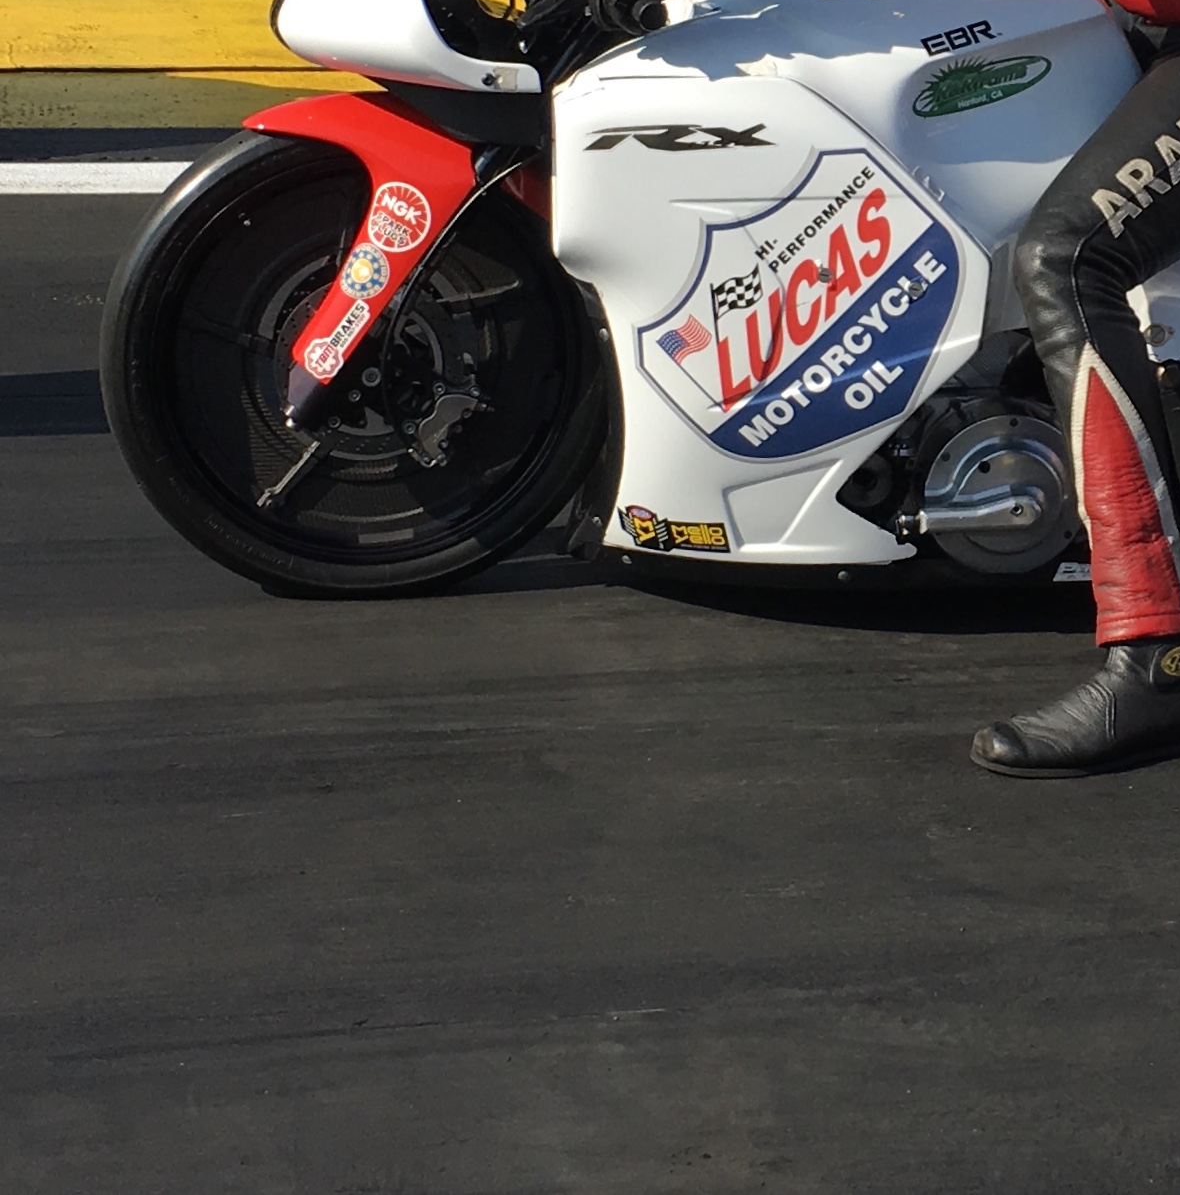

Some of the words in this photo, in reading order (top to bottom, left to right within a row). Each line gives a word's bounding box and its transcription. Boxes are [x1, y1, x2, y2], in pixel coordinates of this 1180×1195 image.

[921, 20, 998, 57] EBR
[380, 194, 422, 225] NGK
[769, 166, 875, 272] PERFORMANCE
[755, 238, 778, 261] HI-
[717, 188, 891, 413] LUCAS
[329, 305, 365, 347] BRAKES
[738, 251, 947, 447] MOTORCYCLE
[844, 360, 904, 410] OIL
